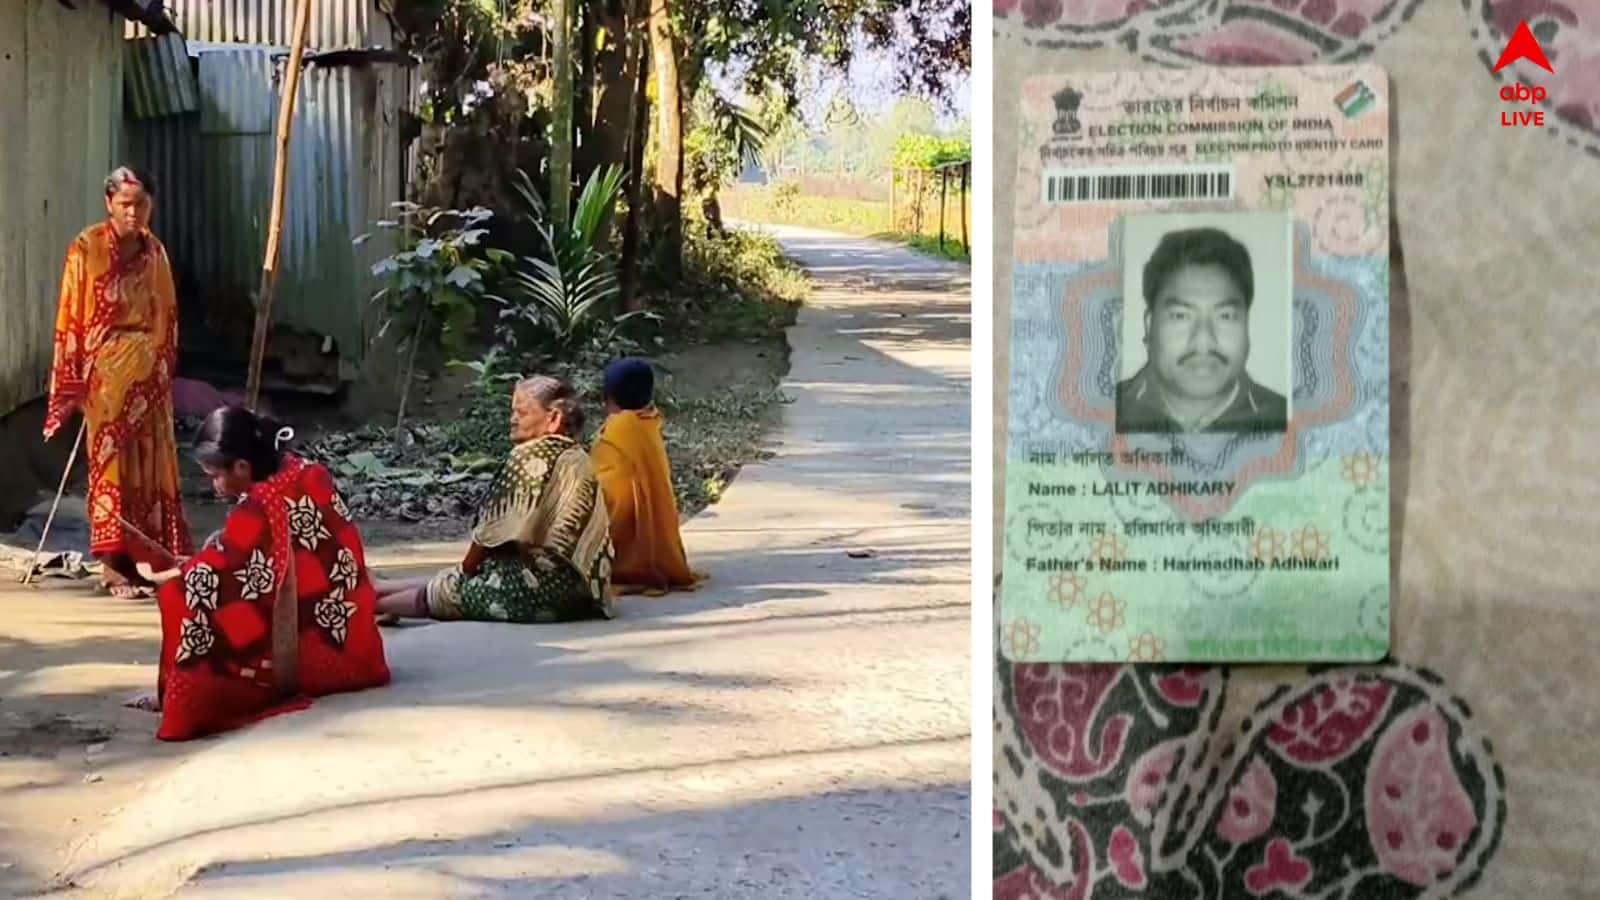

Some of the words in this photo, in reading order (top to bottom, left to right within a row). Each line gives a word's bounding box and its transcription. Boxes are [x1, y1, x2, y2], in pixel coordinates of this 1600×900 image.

[1122, 99, 1183, 114] ভারতের
[1189, 94, 1240, 112] নির্বাচন
[1247, 93, 1298, 110] কমিশন
[1089, 124, 1162, 137] ELECTION
[1167, 121, 1263, 135] COMMISSION
[1268, 120, 1289, 131] OF
[1293, 118, 1333, 130] INDIA
[1195, 142, 1249, 154] ELECTOR
[1252, 140, 1292, 152] PHOTO
[1295, 139, 1346, 151] IDENTITY
[1351, 138, 1383, 149] CARD
[1029, 451, 1056, 465] নাম
[1072, 448, 1114, 466] ললিত
[1120, 446, 1184, 466] অধিকারী
[1028, 482, 1076, 496] Name
[1092, 481, 1141, 496] LALIT
[1145, 481, 1235, 495] ADHIKARY
[1027, 518, 1073, 536] পিতার
[1079, 522, 1105, 537] নাম
[1191, 516, 1255, 537] অধিকারী
[1026, 557, 1094, 571] Father's
[1100, 558, 1147, 571] Name
[1163, 556, 1264, 571] Harimadhab
[1270, 556, 1339, 571] Adhikari
